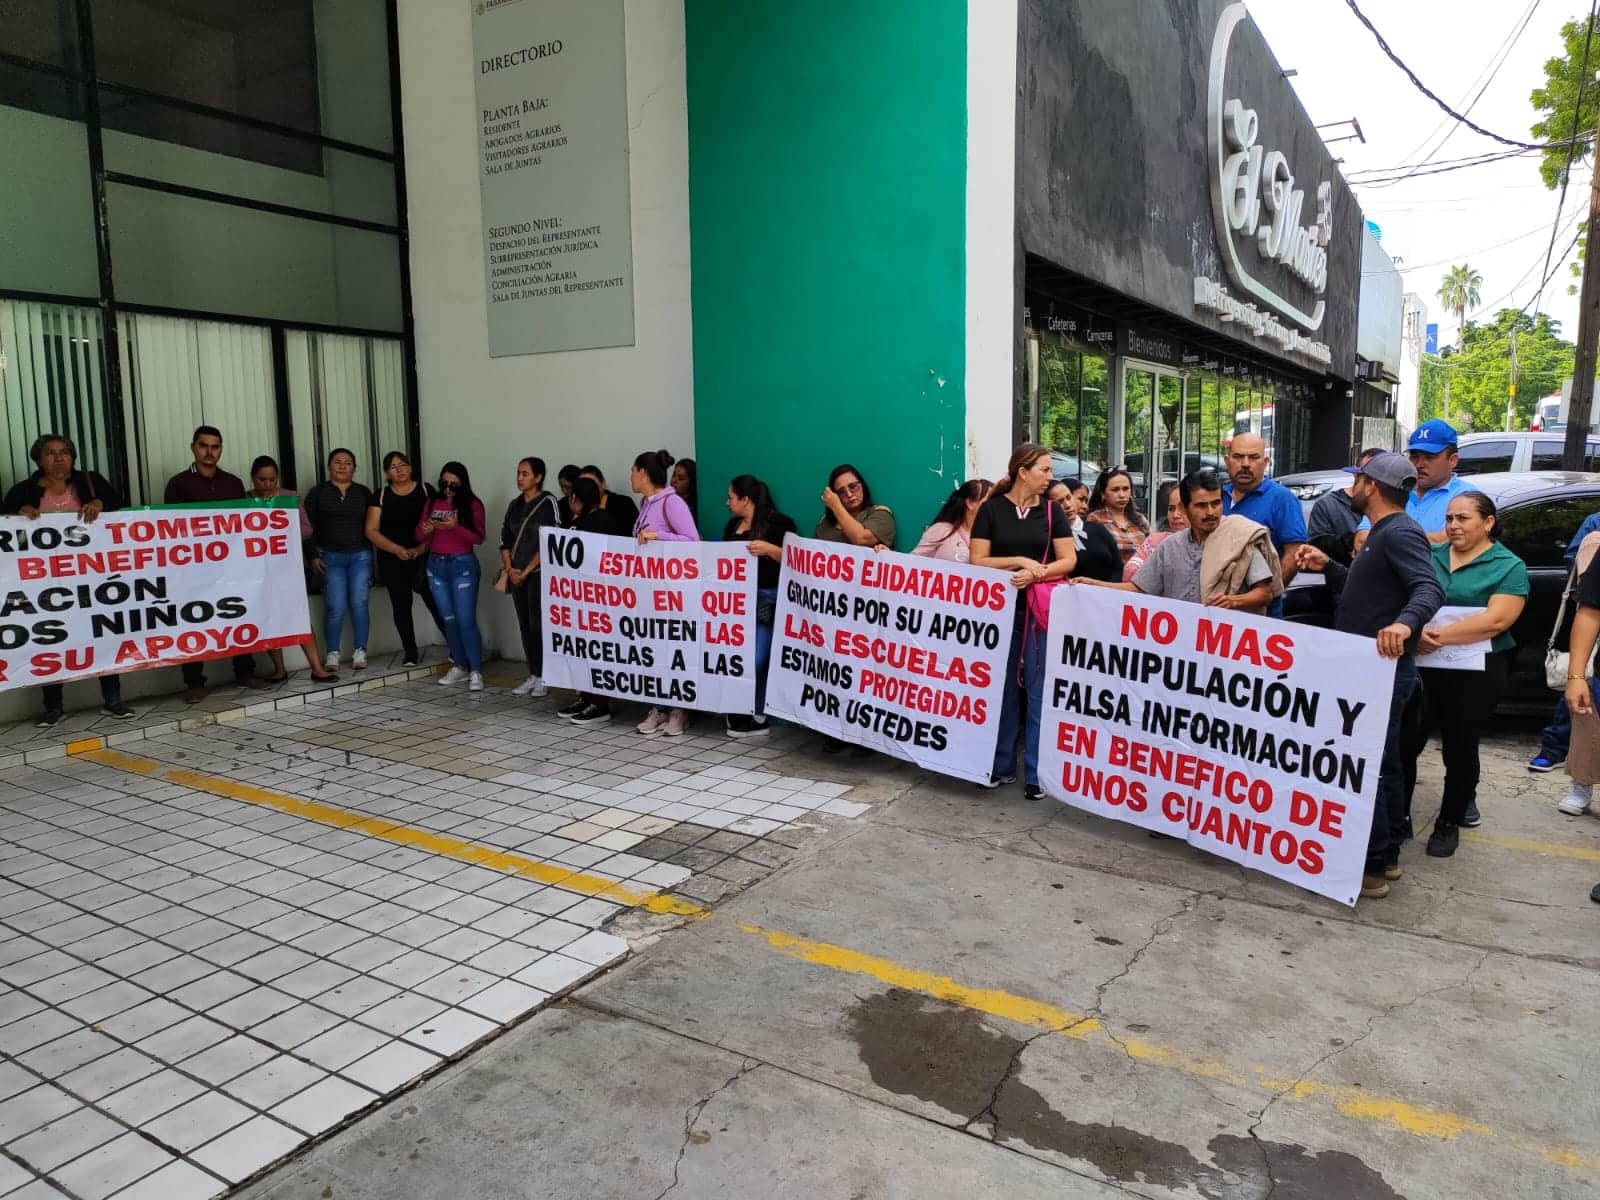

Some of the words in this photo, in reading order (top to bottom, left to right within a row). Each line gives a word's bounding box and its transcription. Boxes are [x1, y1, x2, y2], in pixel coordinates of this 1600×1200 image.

[481, 40, 563, 74] DIRECTORIO
[483, 105, 520, 123] PLANTA
[523, 98, 548, 113] BAJA:
[483, 120, 520, 135] RESIDENTE
[485, 134, 523, 149] ABOGADOS
[525, 124, 561, 139] AGRARIOS
[485, 145, 529, 162] VISITADORES
[531, 137, 568, 152] AGRARIOS
[485, 165, 502, 176] SALA
[504, 162, 513, 171] DE
[515, 157, 542, 169] JUNTAS
[489, 223, 531, 239] SEGUNDO
[533, 218, 562, 231] NIVEL:
[490, 238, 526, 252] DESPACHO
[528, 236, 540, 245] DEL
[542, 226, 601, 243] REPRESENTANTE
[492, 293, 510, 303] SALA
[511, 291, 520, 300] DE
[521, 289, 548, 299] JUNTAS
[549, 286, 562, 295] DEL
[564, 277, 624, 293] REPRESENTANTE
[545, 271, 577, 283] AGRARIA
[1128, 329, 1172, 359] Bienvenidos
[105, 510, 289, 544] TOMEMOS
[18, 540, 229, 580] BENEFICIO
[244, 535, 288, 558] DE
[548, 533, 585, 570] NO
[599, 551, 699, 580] ESTAMOS
[717, 557, 747, 581] DE
[786, 545, 855, 583] AMIGOS
[860, 559, 1006, 612] EJIDATARIOS
[1, 574, 167, 616] ACIÓN
[549, 575, 637, 609] ACUERDO
[653, 590, 683, 612] EN
[701, 590, 746, 617] QUE
[787, 579, 848, 618] GRACIAS
[853, 597, 889, 627] POR
[895, 606, 923, 634] SU
[928, 614, 1000, 650] APOYO
[0, 619, 68, 650] OS
[92, 596, 247, 638] NIÑOS
[549, 604, 572, 628] SE
[578, 609, 613, 634] LES
[619, 615, 697, 642] QUITEN
[705, 621, 745, 647] LAS
[1120, 604, 1178, 645] NO
[1195, 618, 1295, 671] MAS
[30, 646, 94, 677] SU
[115, 623, 259, 664] APOYO
[552, 632, 654, 668] PARCELAS
[670, 649, 685, 671] A
[703, 651, 744, 677] LAS
[784, 614, 825, 647] LAS
[834, 630, 992, 689] ESCUELAS
[590, 668, 696, 702] ESCUELAS
[780, 646, 853, 690] ESTAMOS
[859, 669, 987, 725] PROTEGIDAS
[1061, 634, 1320, 728] MANIPULACIÓN
[1336, 697, 1366, 737] Y
[800, 684, 840, 718] POR
[846, 699, 948, 751] USTEDES
[1053, 677, 1131, 726] FALSA
[1142, 700, 1366, 794] INFORMACIÓN
[1056, 721, 1097, 759] EN
[1108, 735, 1273, 813] BENEFICO
[1289, 790, 1346, 839] DE
[1062, 761, 1148, 813] UNOS
[1162, 792, 1324, 875] CUANTOS
